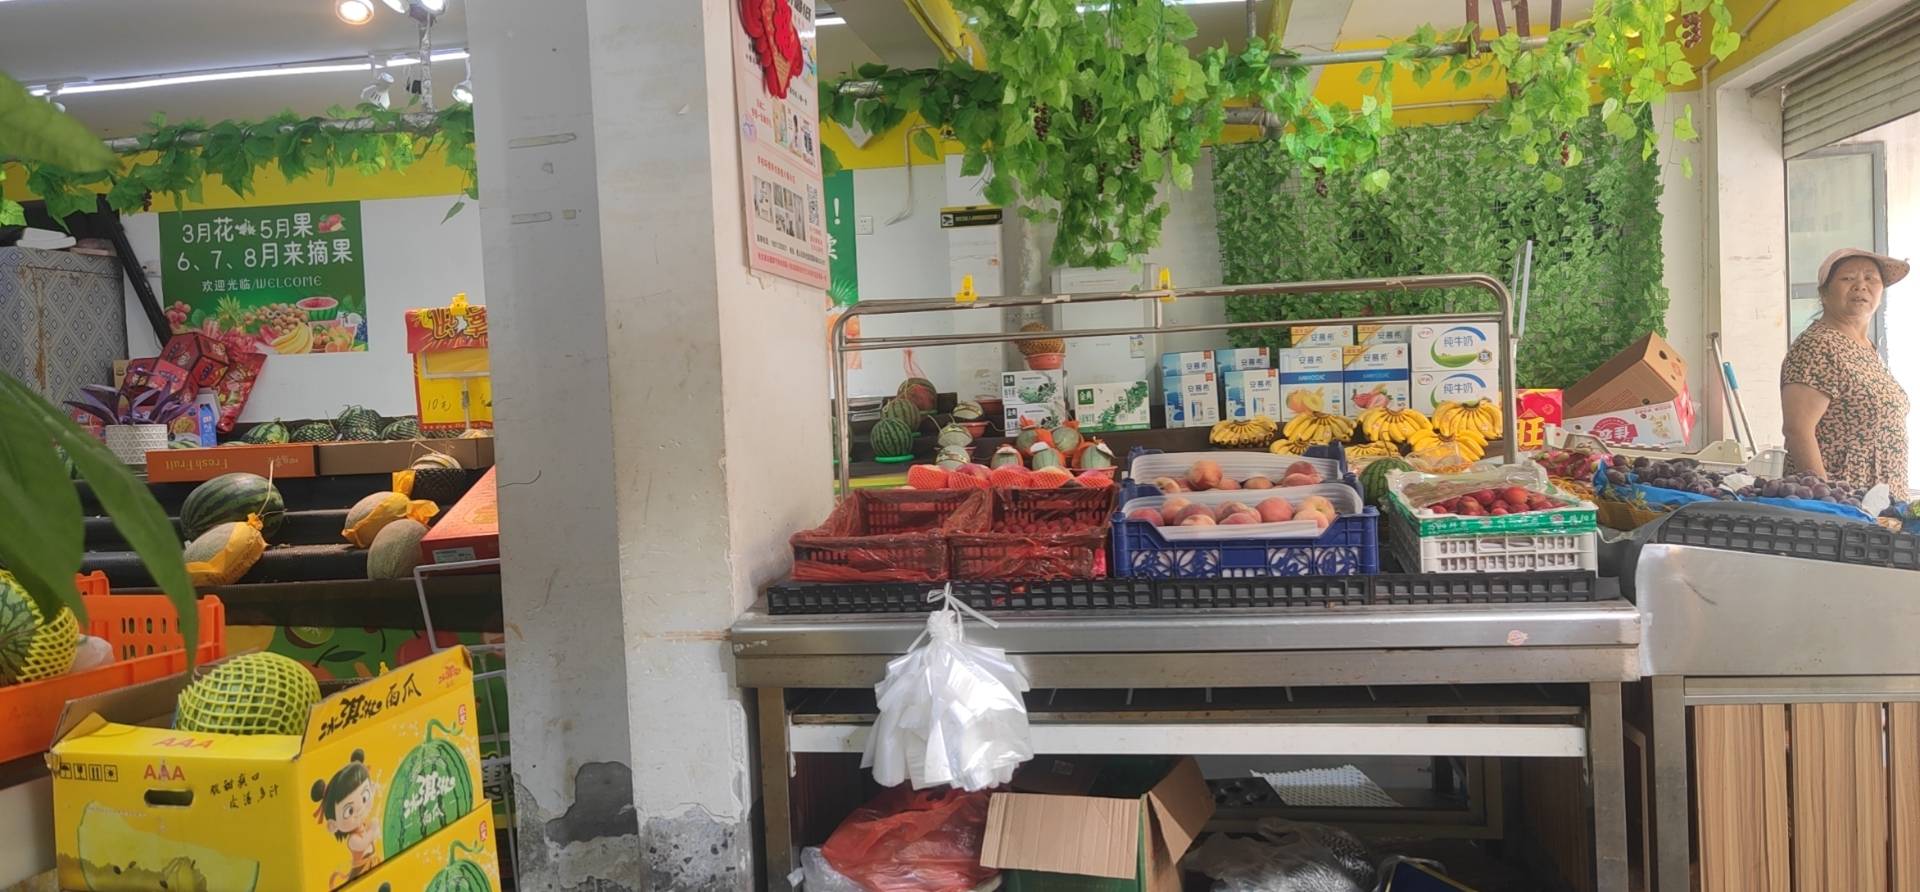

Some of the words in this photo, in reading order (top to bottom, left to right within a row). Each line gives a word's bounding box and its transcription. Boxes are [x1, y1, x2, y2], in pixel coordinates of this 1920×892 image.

[182, 217, 235, 243] 3月花
[260, 212, 314, 239] 5月果
[177, 238, 353, 272] 6、7、8月来摘果
[1443, 335, 1474, 347] 纯牛奶
[1443, 383, 1474, 395] 纯牛奶
[144, 763, 186, 782] AAA
